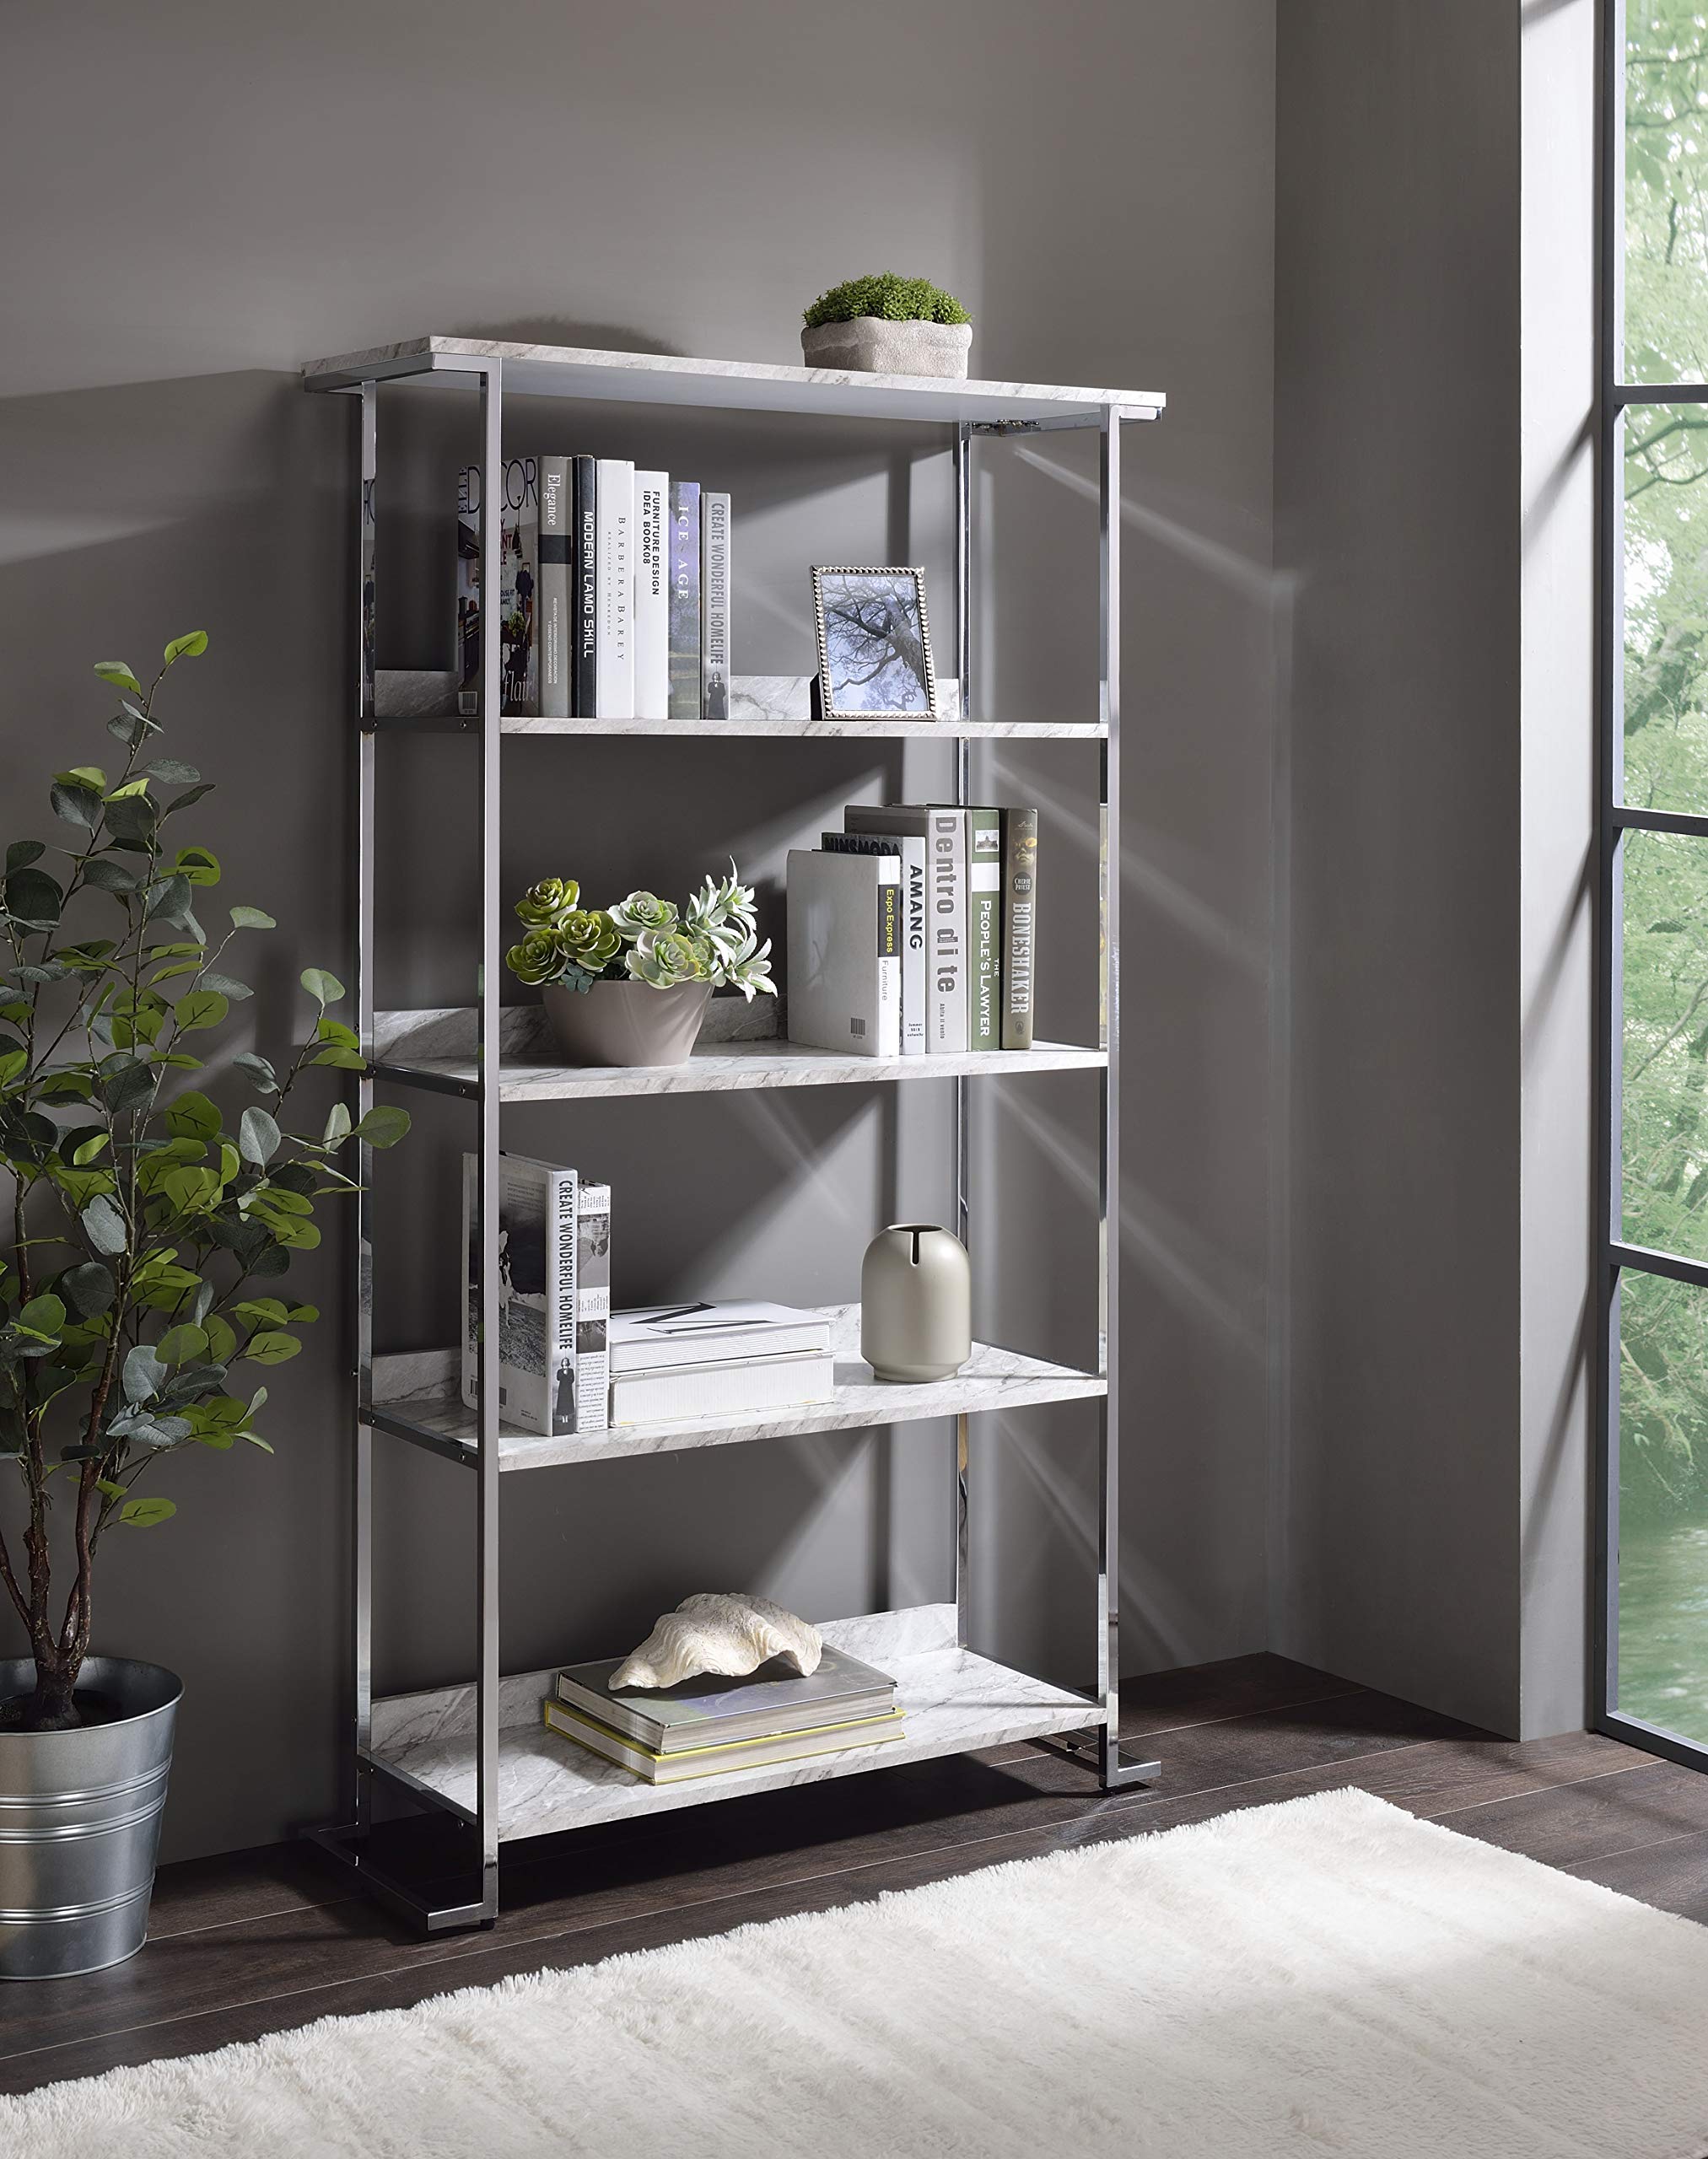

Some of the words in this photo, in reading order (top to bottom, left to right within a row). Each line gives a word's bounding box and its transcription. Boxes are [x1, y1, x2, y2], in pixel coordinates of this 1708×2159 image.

[467, 458, 538, 514] DOR
[543, 473, 561, 526] Elegance
[584, 511, 594, 569] MODERN
[643, 521, 651, 564] BOOK08
[678, 506, 689, 541] ICE
[711, 503, 725, 540] CREATE
[617, 517, 626, 597] BARBERA
[678, 558, 689, 600] AGE
[711, 542, 725, 609] WONDERFUL
[584, 574, 594, 614] LAMO
[584, 619, 595, 658] SKILL
[617, 606, 626, 660] BAREY
[710, 611, 725, 665] HOMELIFE
[935, 816, 957, 914] Dentro
[886, 889, 894, 913] Expo
[909, 864, 923, 950] AMANG
[886, 915, 894, 953] Express
[936, 928, 958, 956] di
[980, 900, 992, 972] PEOPLE'S
[1010, 902, 1032, 1015] BONESHAKER
[936, 966, 958, 993] te
[979, 974, 992, 1036] LAWYER
[559, 1180, 574, 1219] CREATE
[559, 1222, 574, 1292] WONDERFUL
[558, 1294, 574, 1350] HOMELIFE
